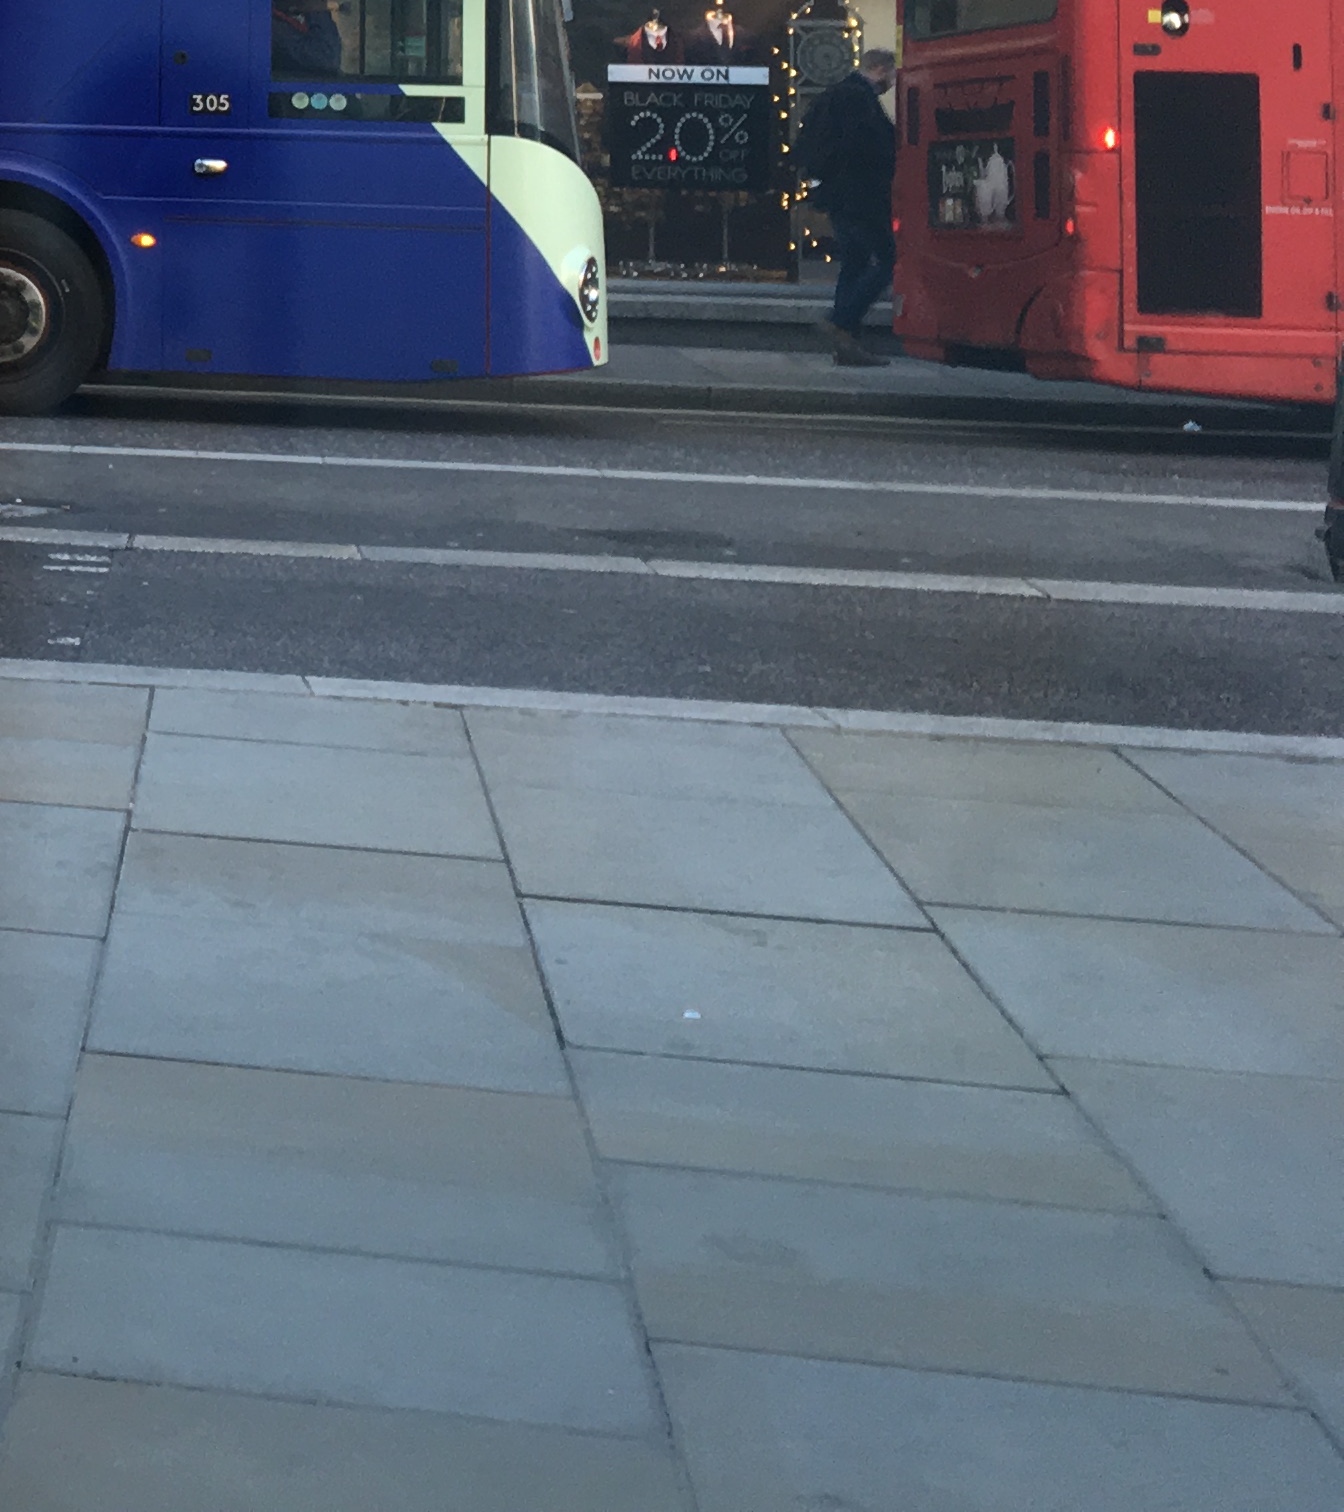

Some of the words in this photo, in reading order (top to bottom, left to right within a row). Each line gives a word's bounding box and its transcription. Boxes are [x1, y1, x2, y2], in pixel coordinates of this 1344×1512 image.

[648, 68, 694, 81] NOW
[701, 68, 729, 82] ON
[192, 94, 230, 111] 305
[623, 91, 683, 107] BLACK
[694, 92, 755, 108] FRIDAY
[630, 165, 749, 184] EVERYTHING
